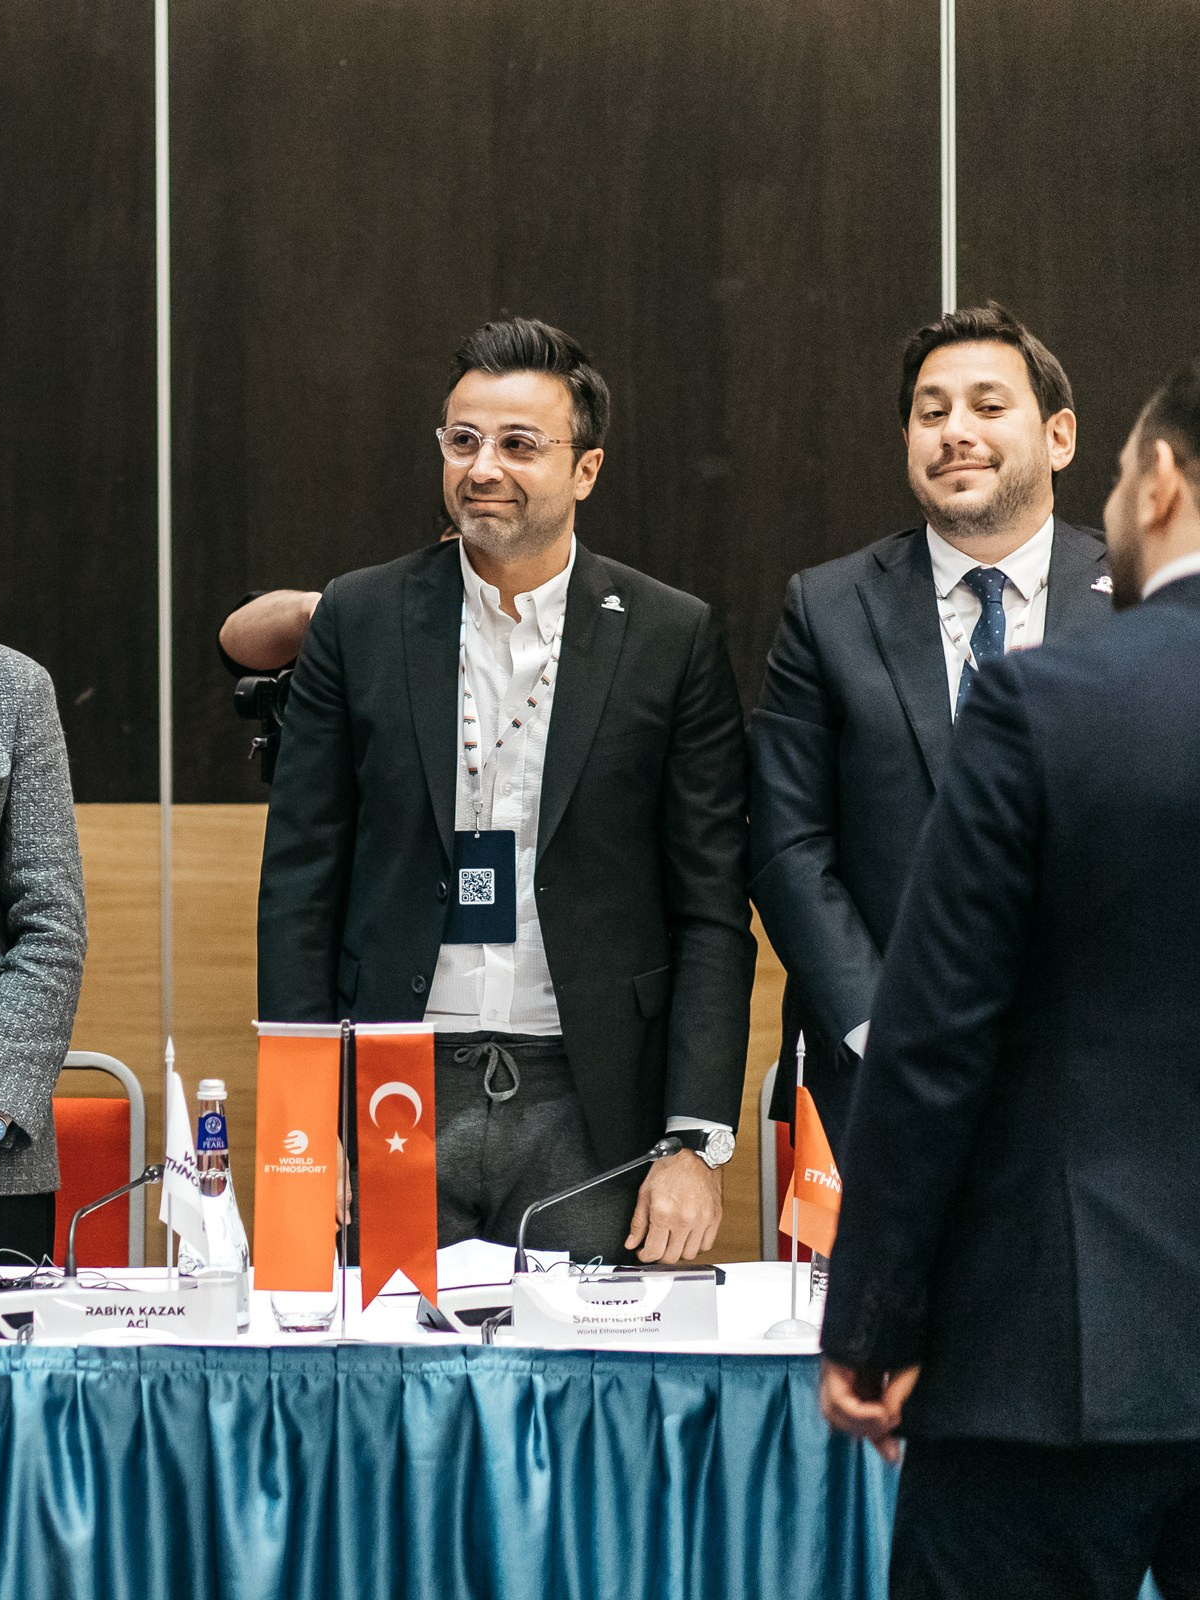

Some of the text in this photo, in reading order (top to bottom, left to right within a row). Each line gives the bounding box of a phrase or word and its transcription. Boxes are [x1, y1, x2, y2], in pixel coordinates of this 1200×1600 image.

[202, 1140, 225, 1149] PEARL
[278, 1157, 314, 1165] WORLD
[264, 1164, 328, 1174] ETHNOSPORT
[804, 1167, 841, 1194] ETHN
[85, 1304, 186, 1316] RABİYA KAZAK
[599, 1327, 637, 1335] Ethnosport
